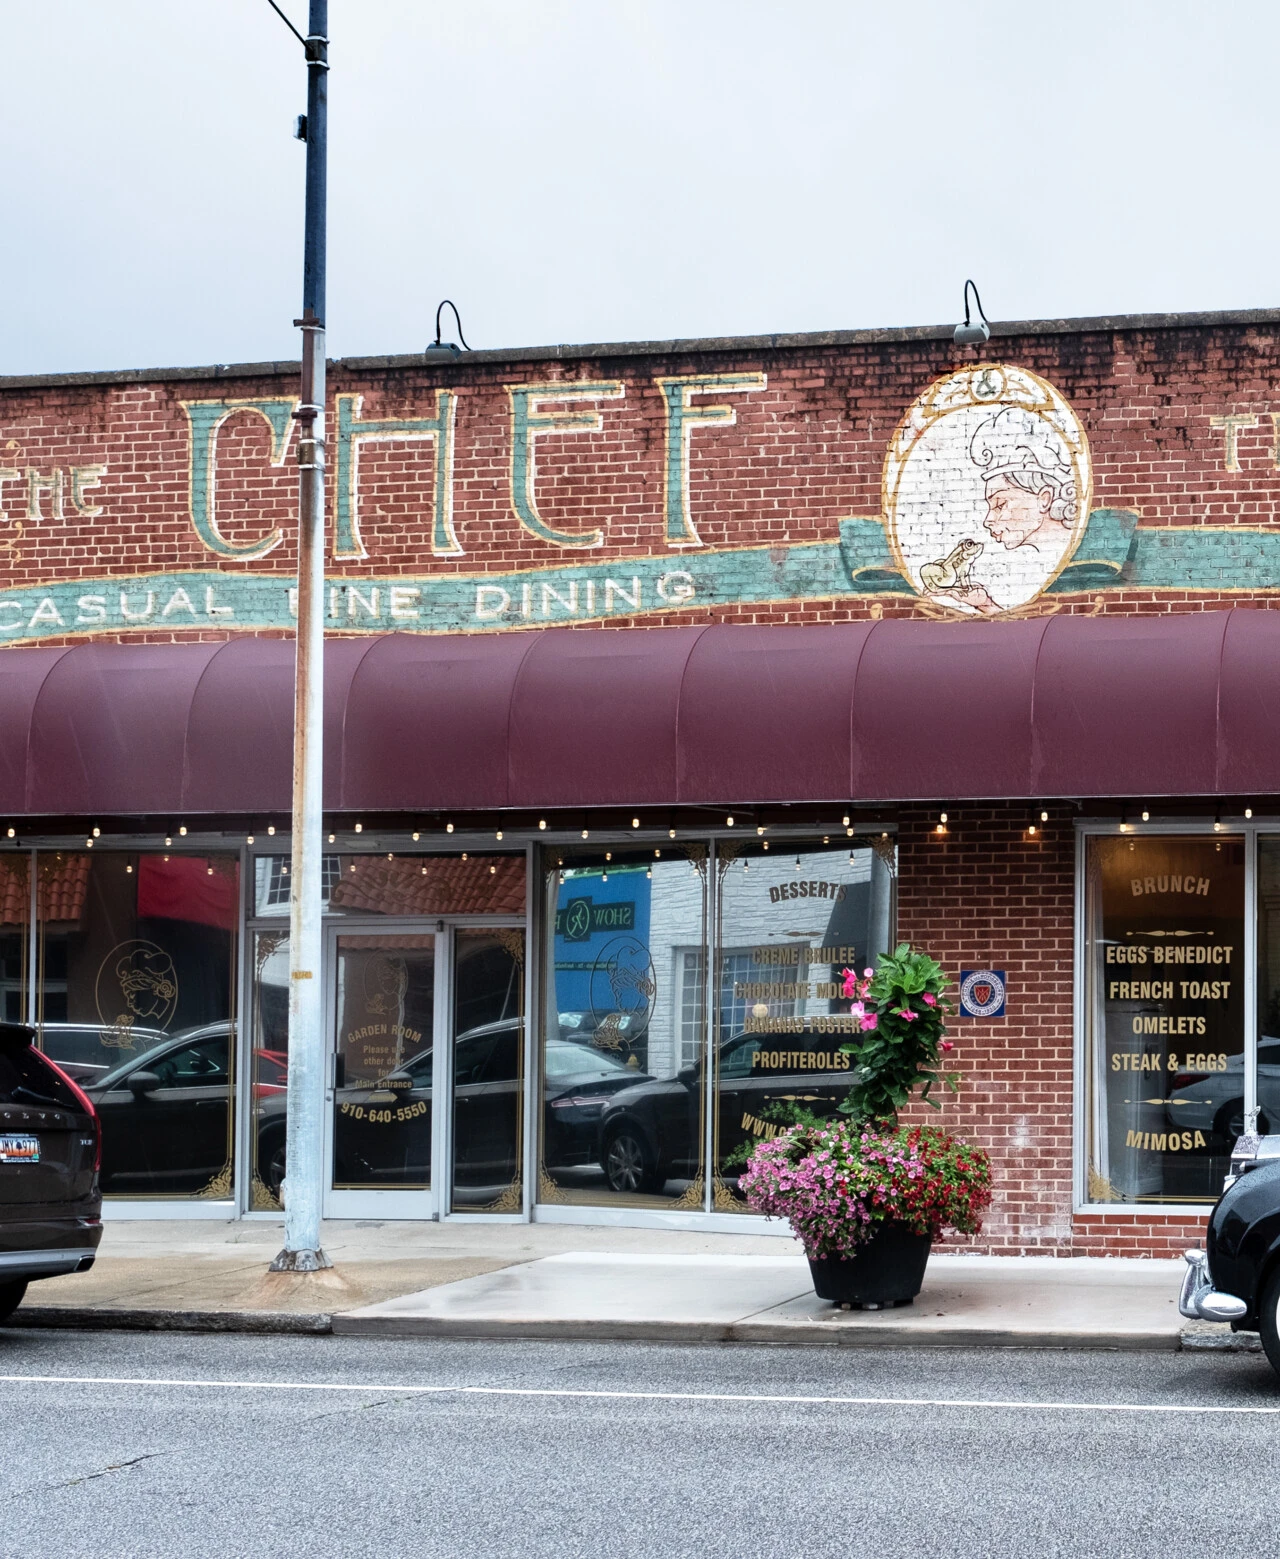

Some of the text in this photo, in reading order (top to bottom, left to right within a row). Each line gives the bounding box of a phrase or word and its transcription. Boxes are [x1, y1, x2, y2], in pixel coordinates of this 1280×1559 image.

[178, 371, 768, 563] CHEF
[475, 571, 697, 620] DINING
[769, 881, 848, 904] DESSERTS
[1131, 875, 1211, 896] BRUNCH
[752, 946, 856, 965] CREME BRULEE
[1106, 946, 1233, 964] EGGS BENEDICT
[734, 982, 811, 1000] CHOCOLATE
[1110, 981, 1231, 999] FRENCH TOAST
[347, 1024, 422, 1044] GARDEN ROOM
[743, 1016, 805, 1034] BANANAS
[1132, 1016, 1206, 1035] OMELETS
[363, 1044, 390, 1054] Please
[364, 1057, 385, 1065] other
[752, 1051, 851, 1069] PROFITEROLES
[1111, 1053, 1228, 1072] STEAK & EGGS
[378, 1068, 390, 1077] for
[355, 1080, 413, 1089] Main Entrance
[341, 1100, 427, 1123] 910-640-5550
[1125, 1130, 1206, 1151] MIMOSA
